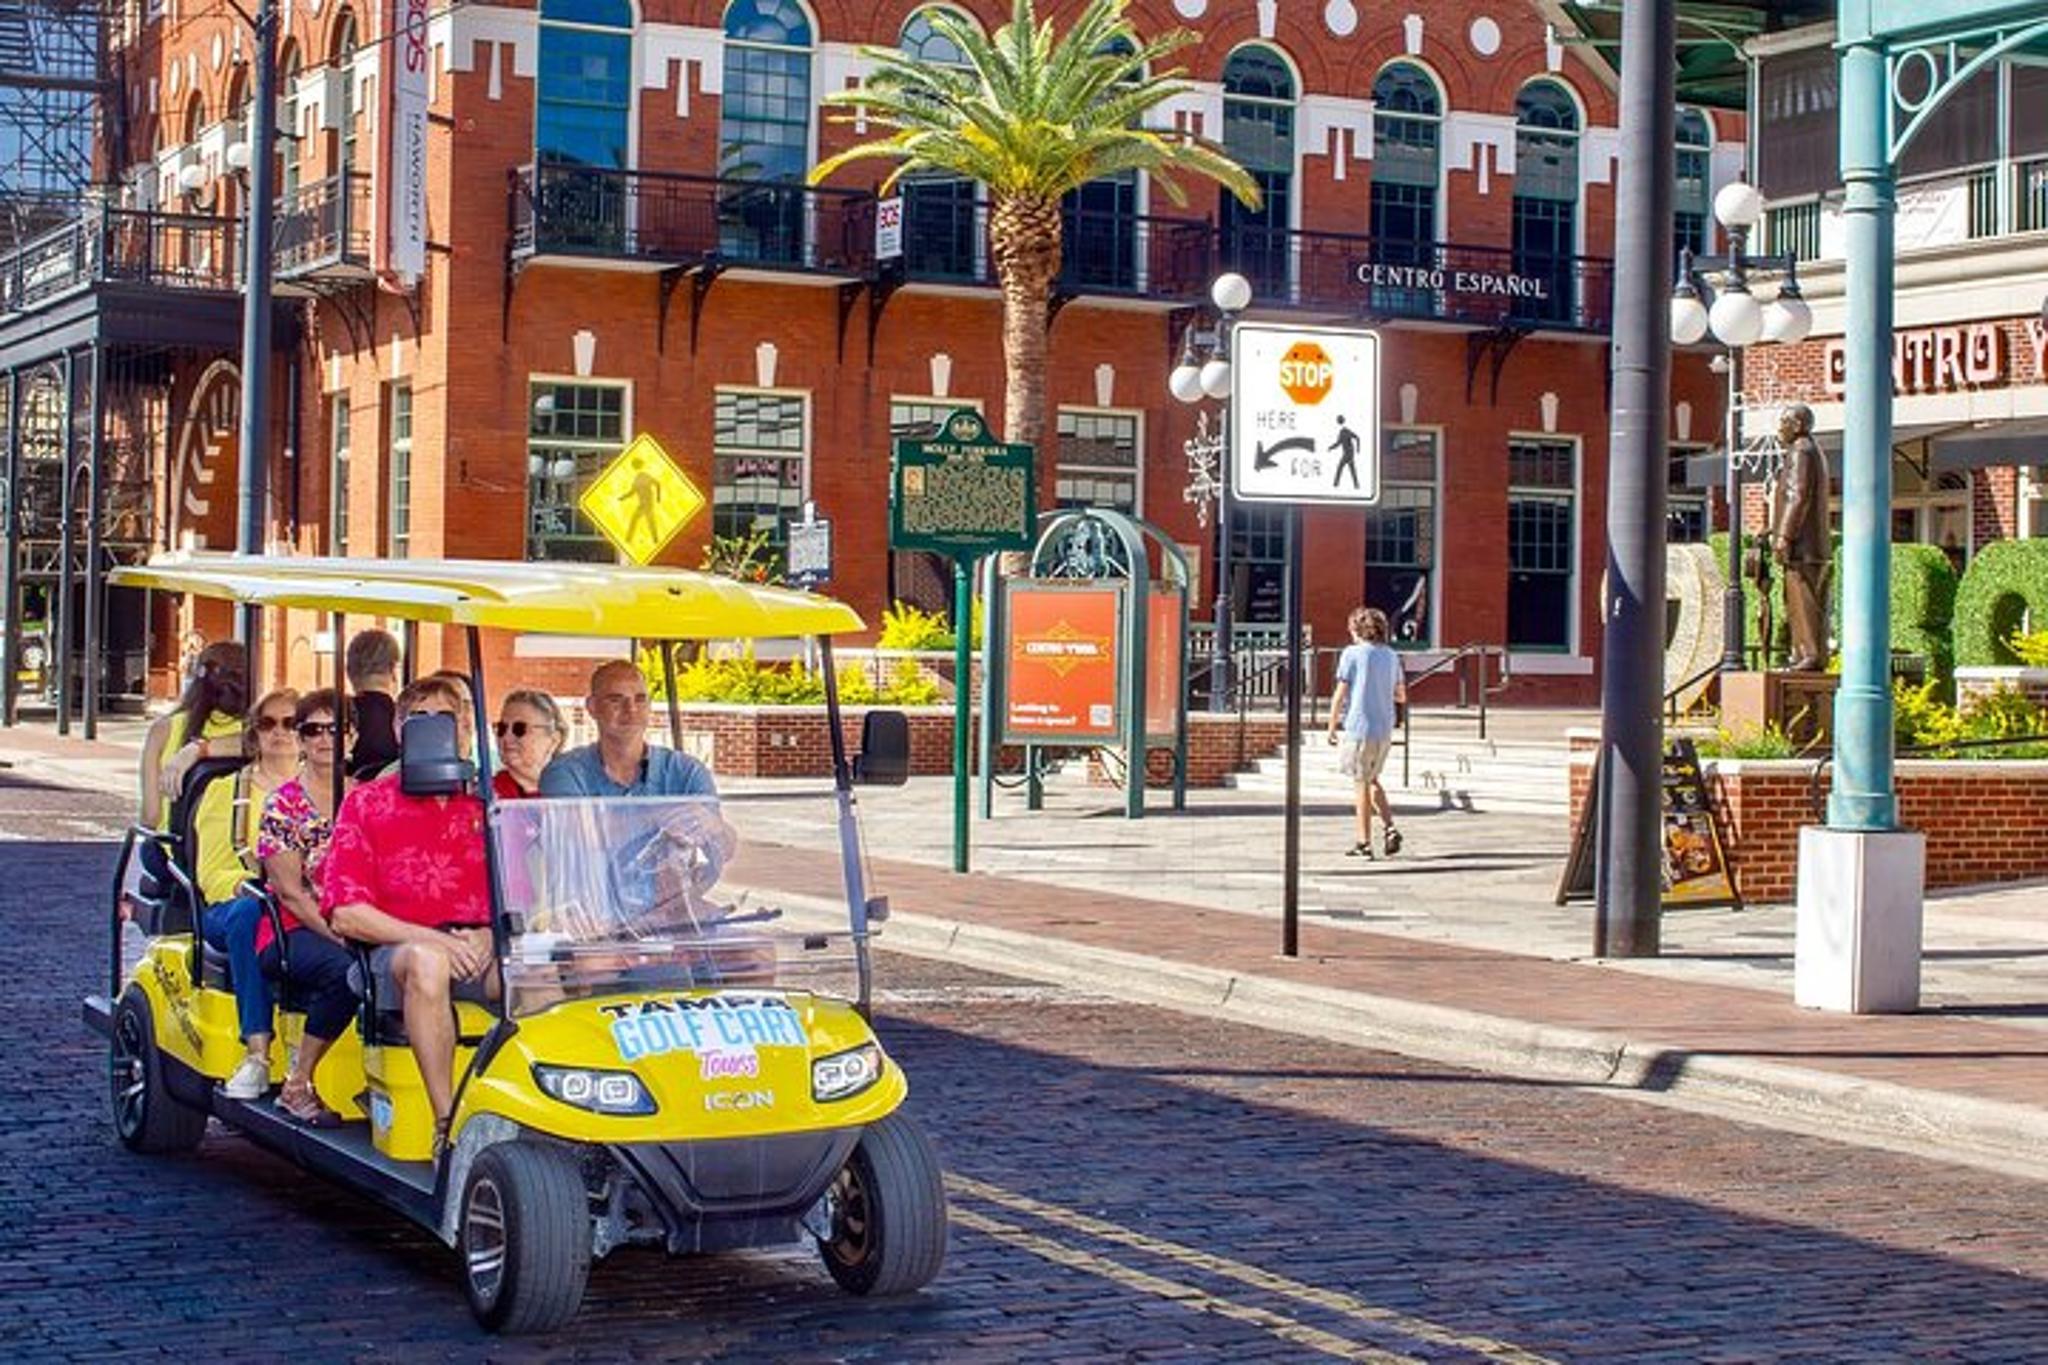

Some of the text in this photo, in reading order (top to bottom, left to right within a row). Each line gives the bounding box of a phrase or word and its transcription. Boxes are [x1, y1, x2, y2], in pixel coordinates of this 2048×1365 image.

[881, 204, 899, 228] BOS
[1357, 264, 1549, 299] CENTRO ESPAÑOL
[1281, 361, 1332, 388] STOP
[1256, 410, 1297, 430] HERE
[1291, 457, 1322, 478] FOR
[613, 1008, 806, 1060] GOLF CART
[702, 1050, 757, 1077] Tours
[705, 1091, 773, 1110] ICON
